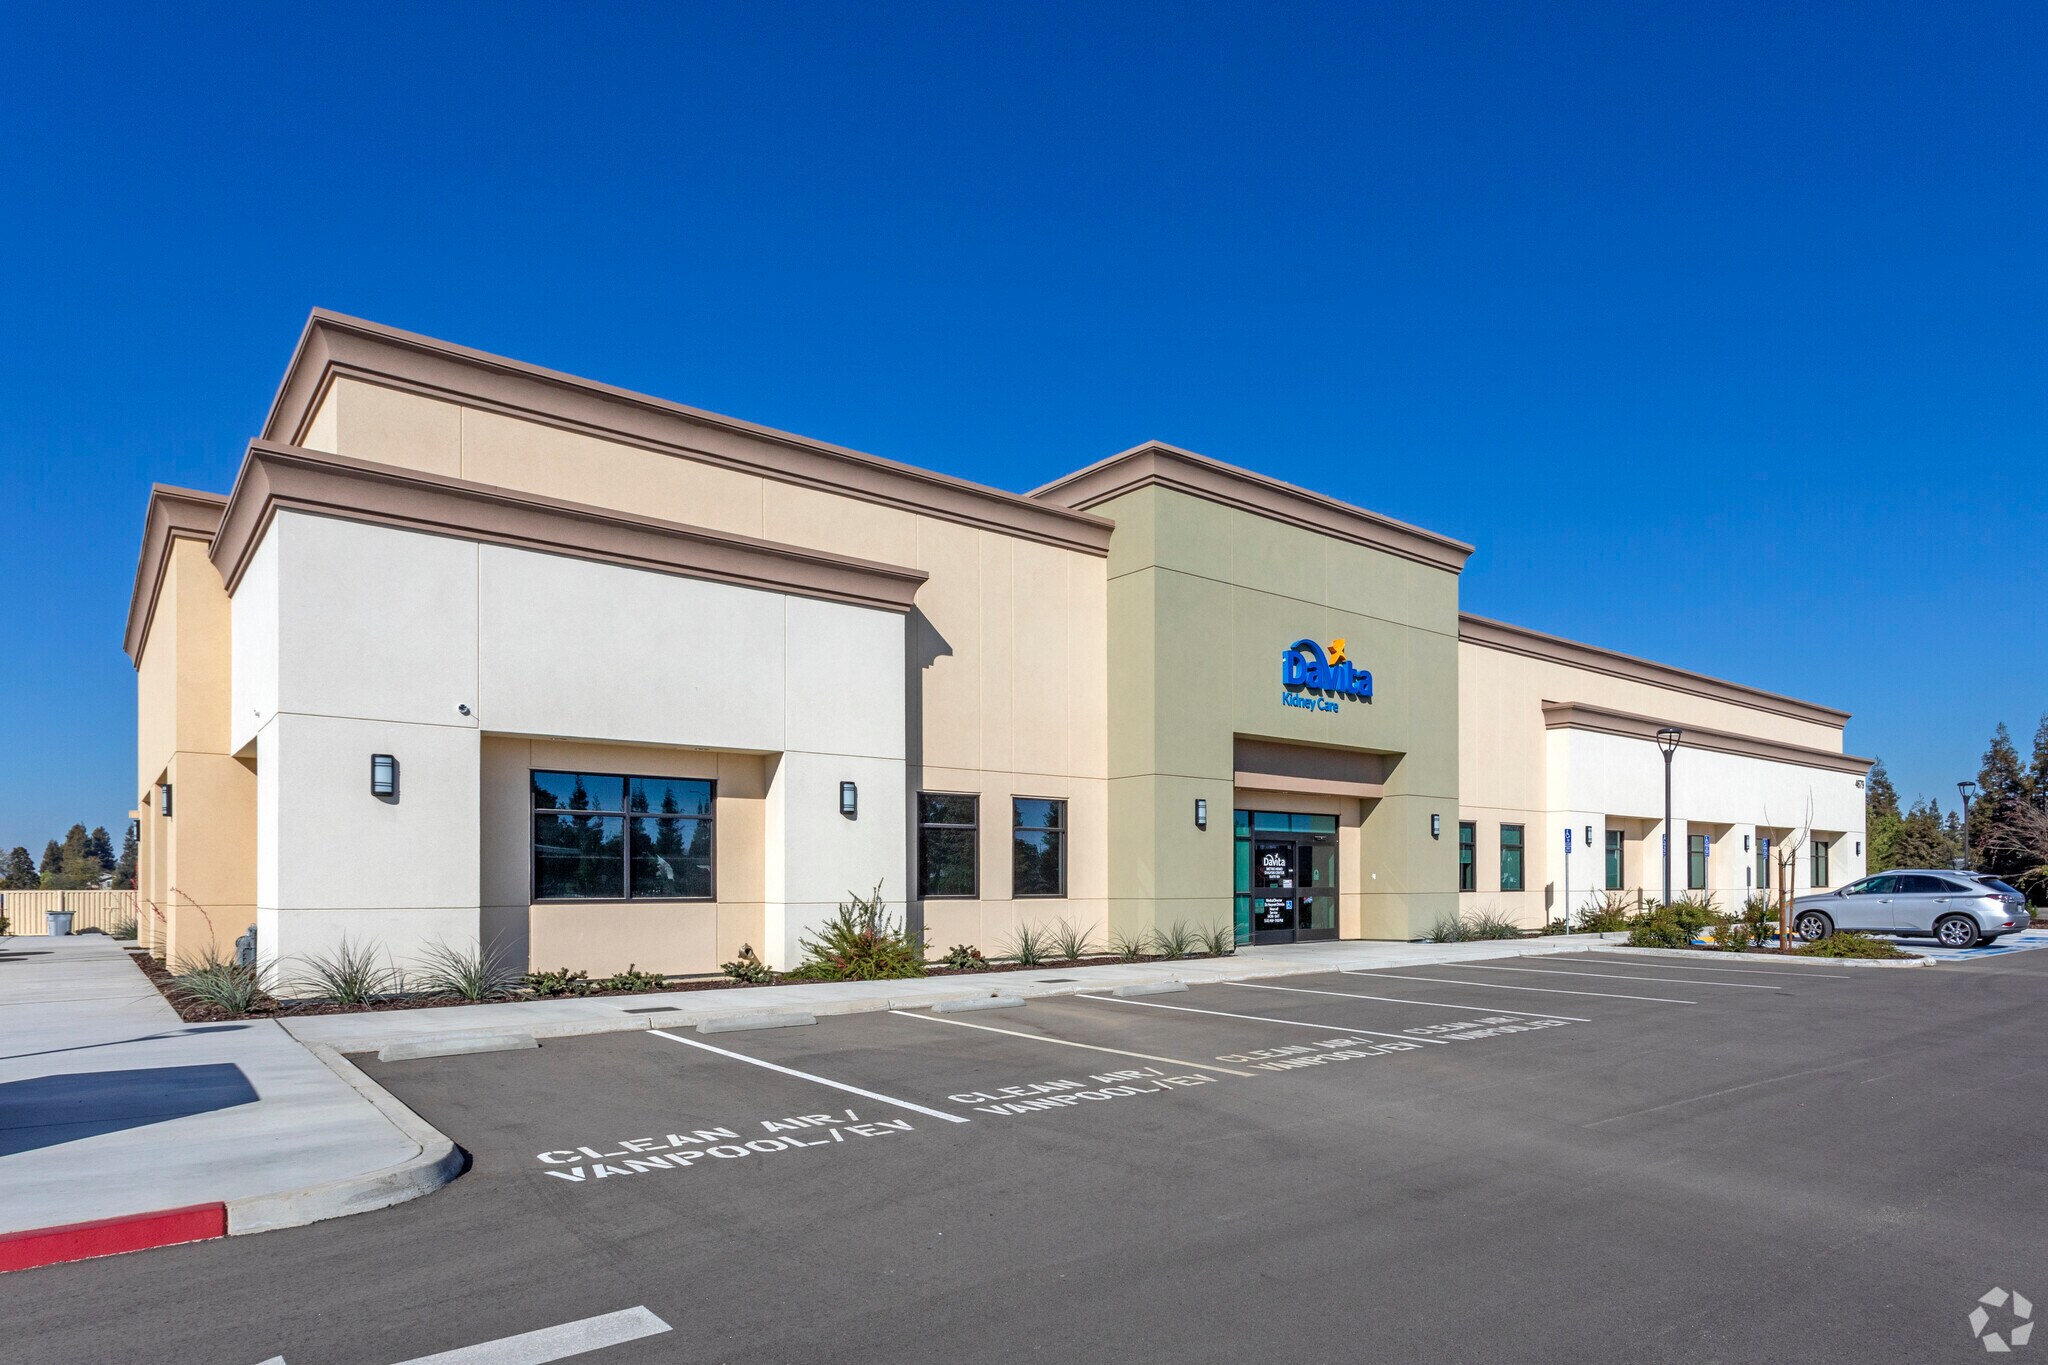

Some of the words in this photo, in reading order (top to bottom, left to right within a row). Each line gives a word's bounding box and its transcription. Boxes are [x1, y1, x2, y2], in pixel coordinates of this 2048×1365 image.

[1282, 638, 1373, 698] DaVita
[1282, 692, 1316, 712] Kidney
[1317, 697, 1339, 713] Care
[1263, 853, 1286, 867] DaVita
[1215, 1045, 1319, 1063] CLEAN
[1248, 1041, 1424, 1071] VANPOOL/EV
[948, 1079, 1087, 1103] CLEAN
[973, 1073, 1219, 1116] VANPOOL/EV
[536, 1127, 741, 1164] CLEAN
[544, 1119, 915, 1182] VANPOOL/EV
